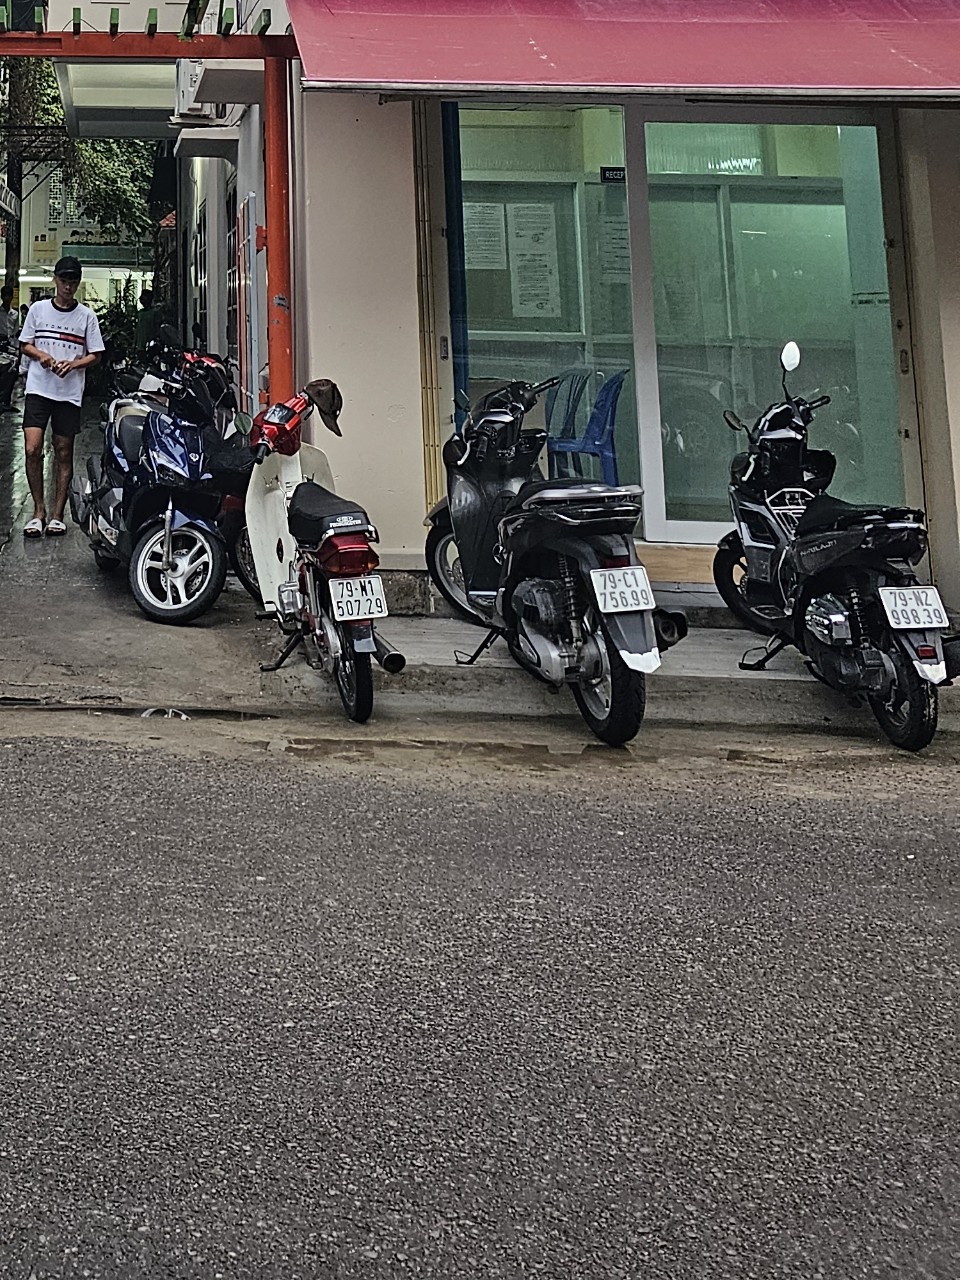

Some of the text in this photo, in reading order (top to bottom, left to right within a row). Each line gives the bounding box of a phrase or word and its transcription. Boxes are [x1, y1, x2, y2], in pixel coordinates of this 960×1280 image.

[338, 580, 375, 598] 79-N1
[600, 570, 639, 590] 79-C1
[336, 597, 383, 617] 507.29
[599, 589, 650, 609] 756.99
[889, 590, 933, 608] 79-N2
[891, 608, 944, 625] 998.39
